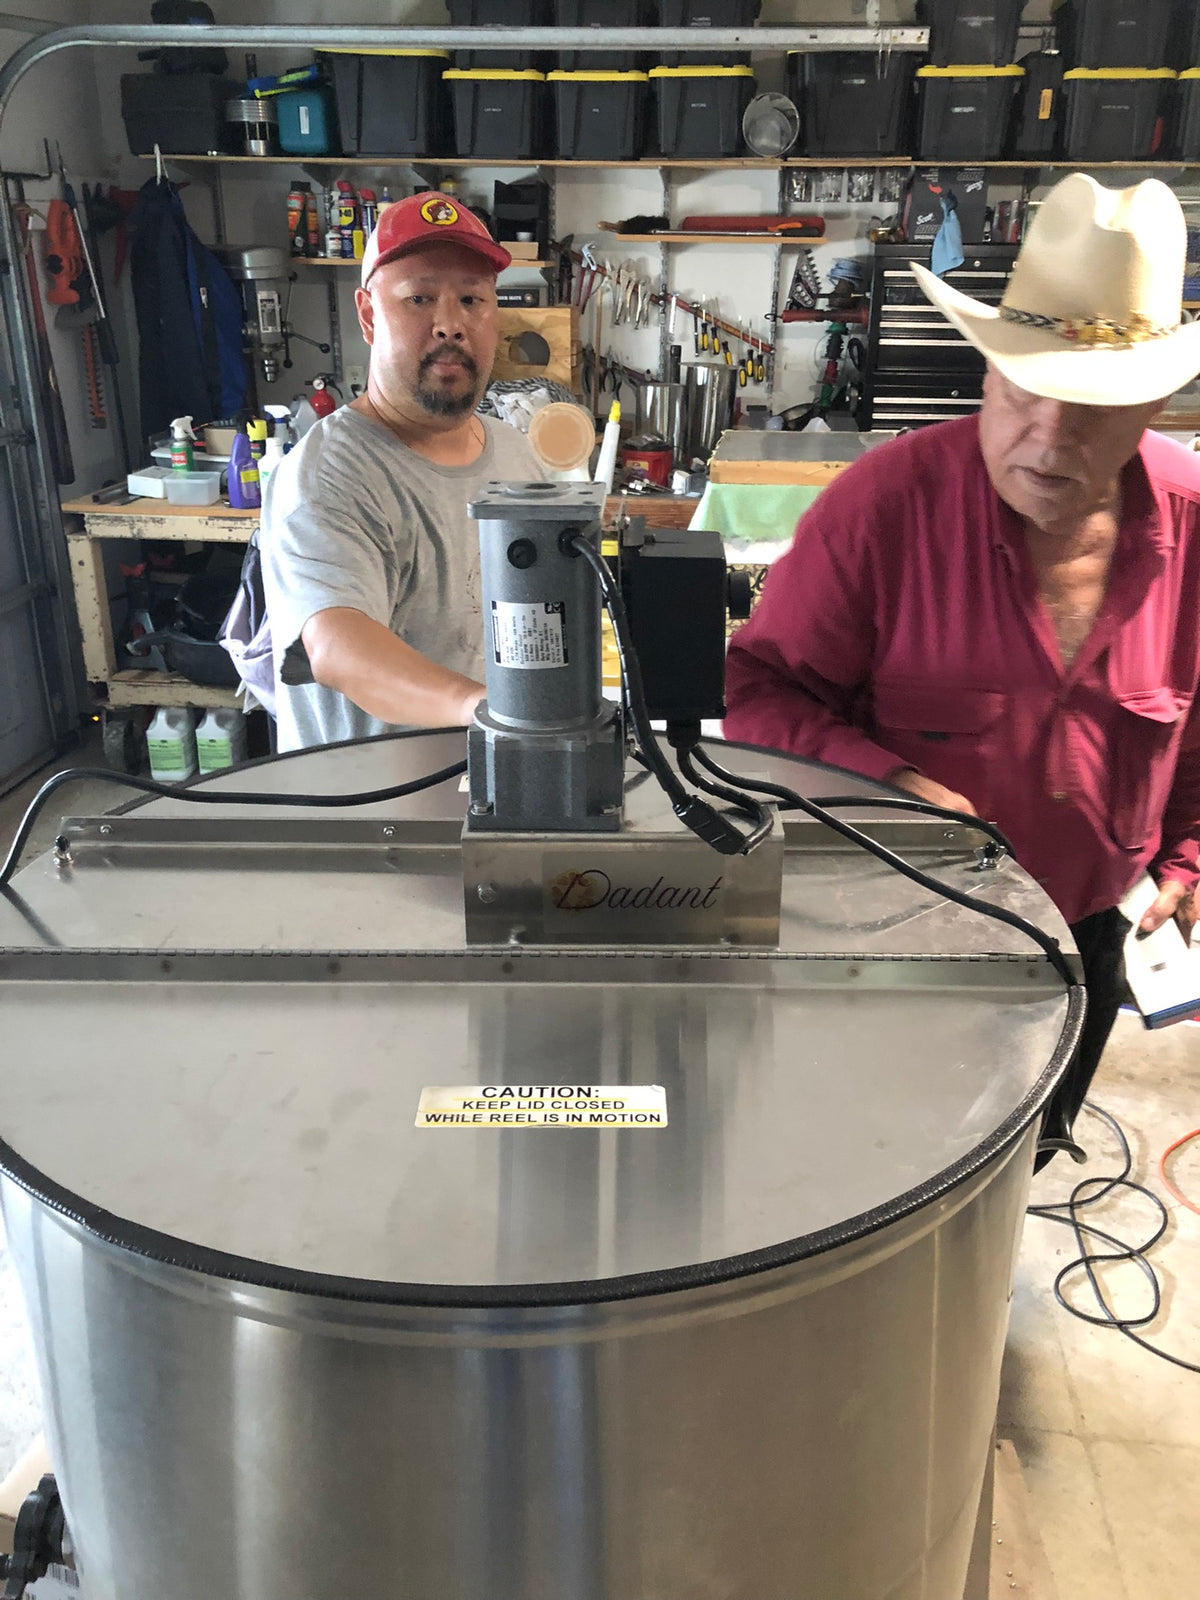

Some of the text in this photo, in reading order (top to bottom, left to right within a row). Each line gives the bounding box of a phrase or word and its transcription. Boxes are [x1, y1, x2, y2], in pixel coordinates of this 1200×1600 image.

[557, 869, 723, 909] Dadant
[482, 1086, 599, 1098] CAUTION:
[462, 1101, 625, 1110] KEEP LID CLOSED
[425, 1113, 660, 1122] WHILE REEL IS IN MOTION
